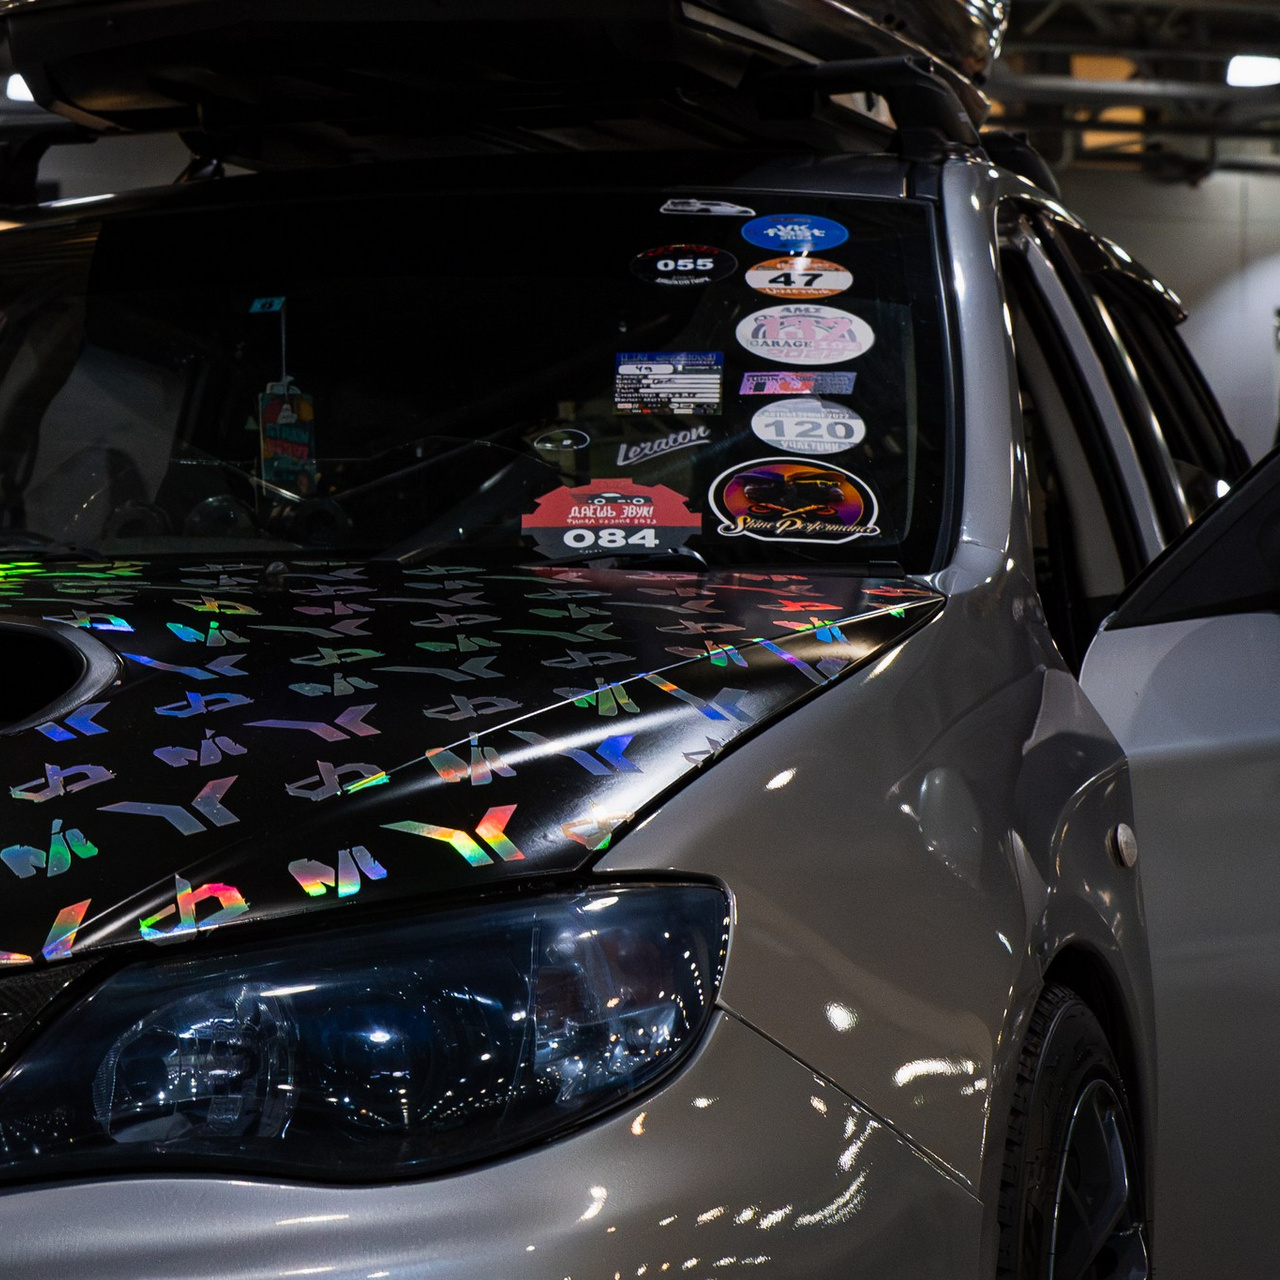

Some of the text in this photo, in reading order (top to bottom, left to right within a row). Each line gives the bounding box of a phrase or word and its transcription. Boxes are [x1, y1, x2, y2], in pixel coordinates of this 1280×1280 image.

[656, 258, 714, 271] 055
[768, 272, 823, 286] 47
[764, 420, 855, 440] 120
[620, 505, 654, 517] ЗВУК!
[563, 528, 660, 548] 084
